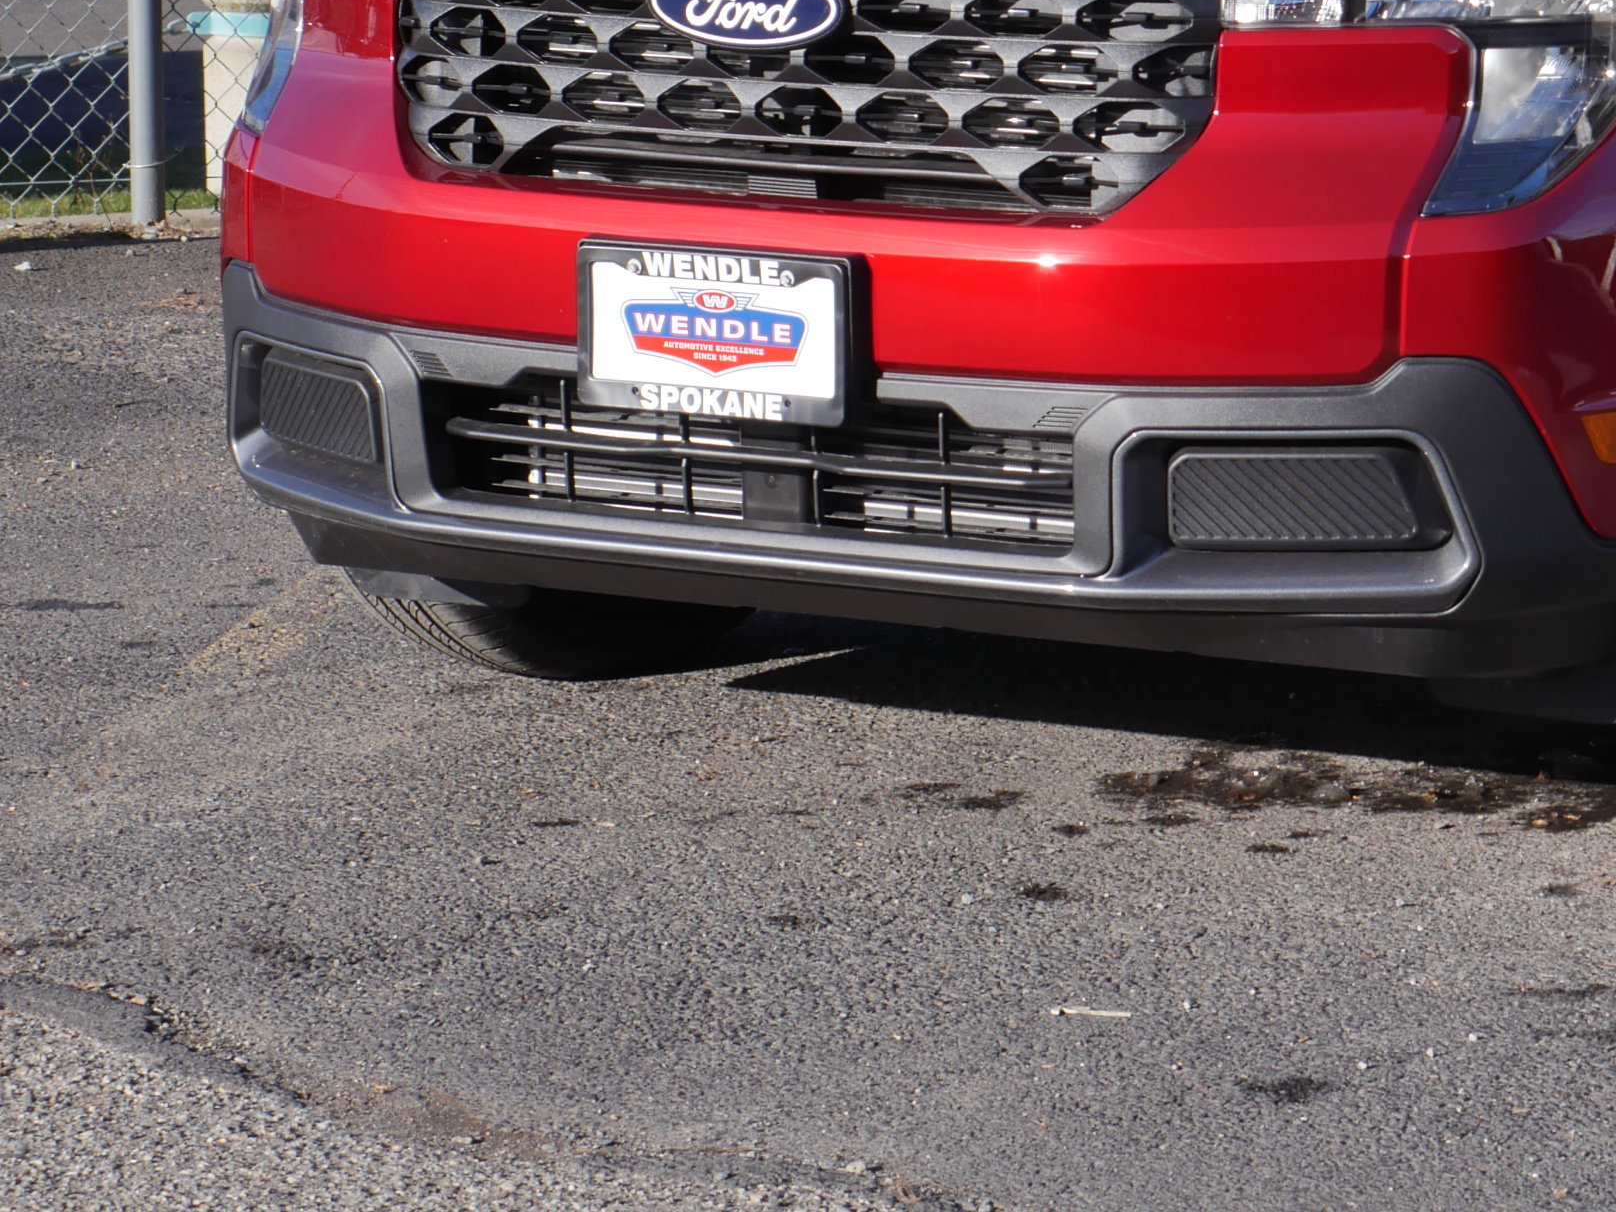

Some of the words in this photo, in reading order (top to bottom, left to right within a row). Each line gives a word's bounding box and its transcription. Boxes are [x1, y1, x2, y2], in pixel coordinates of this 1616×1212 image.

[642, 251, 780, 286] WENDLE
[633, 312, 791, 344] WENDLE
[663, 341, 713, 352] AUTOMOTIVE
[715, 345, 764, 356] EXCELLENCE
[693, 352, 717, 361] SINCE
[718, 354, 738, 362] 1943
[639, 383, 783, 421] SPOKANE
